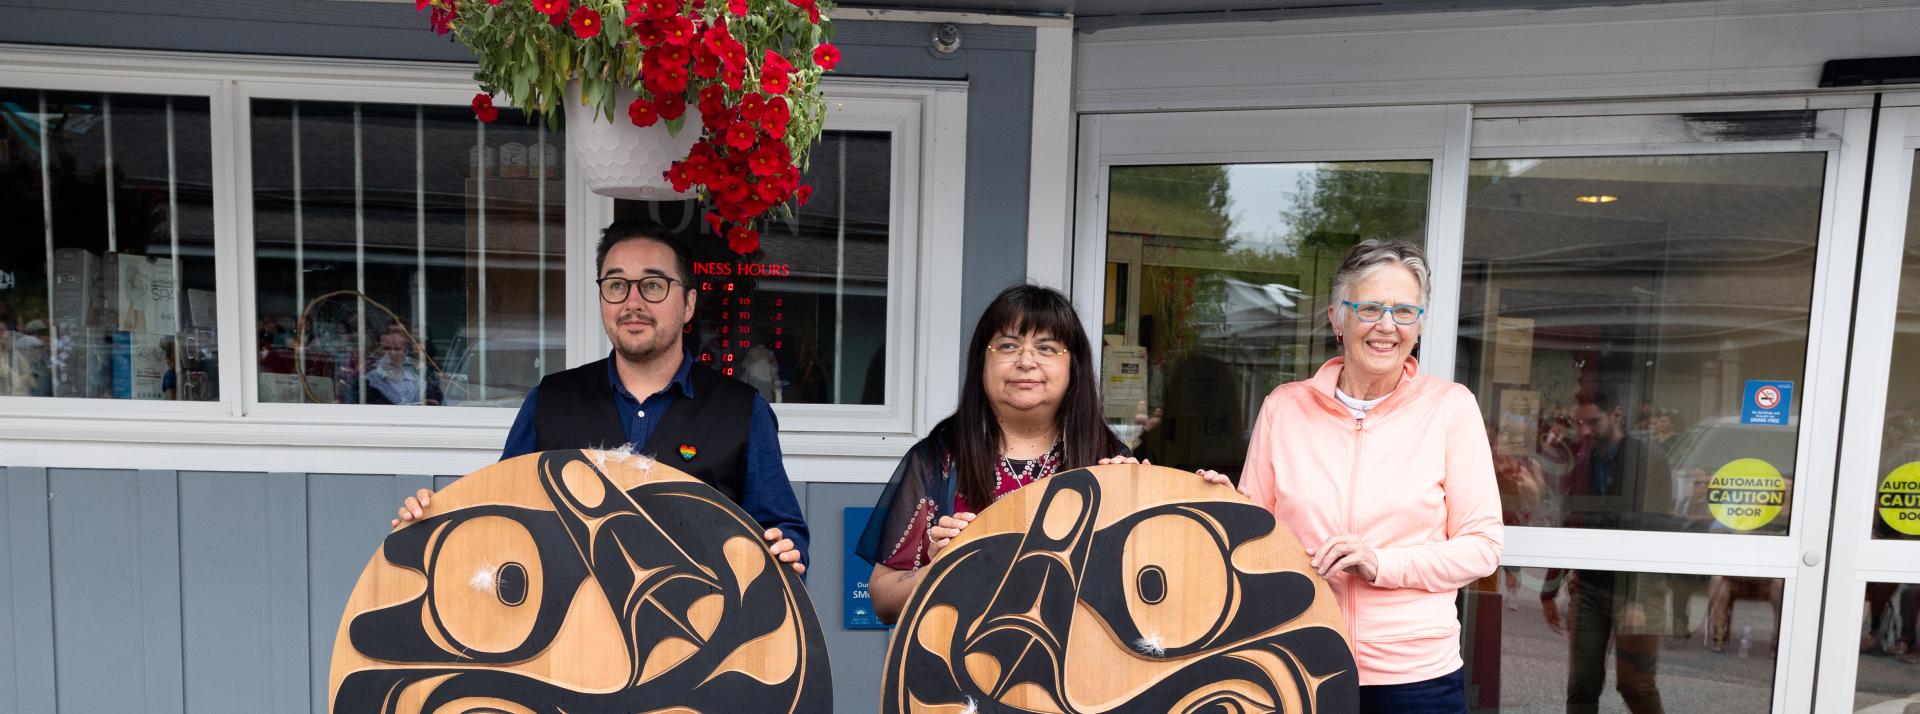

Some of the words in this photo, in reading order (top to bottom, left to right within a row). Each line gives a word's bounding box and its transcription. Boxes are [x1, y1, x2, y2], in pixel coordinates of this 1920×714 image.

[737, 263, 790, 277] HOURS
[1711, 478, 1781, 488] AUTOMATIC
[1883, 481, 1920, 490] AUTO
[1709, 490, 1783, 504] CAUTION
[1727, 507, 1762, 517] DOOR
